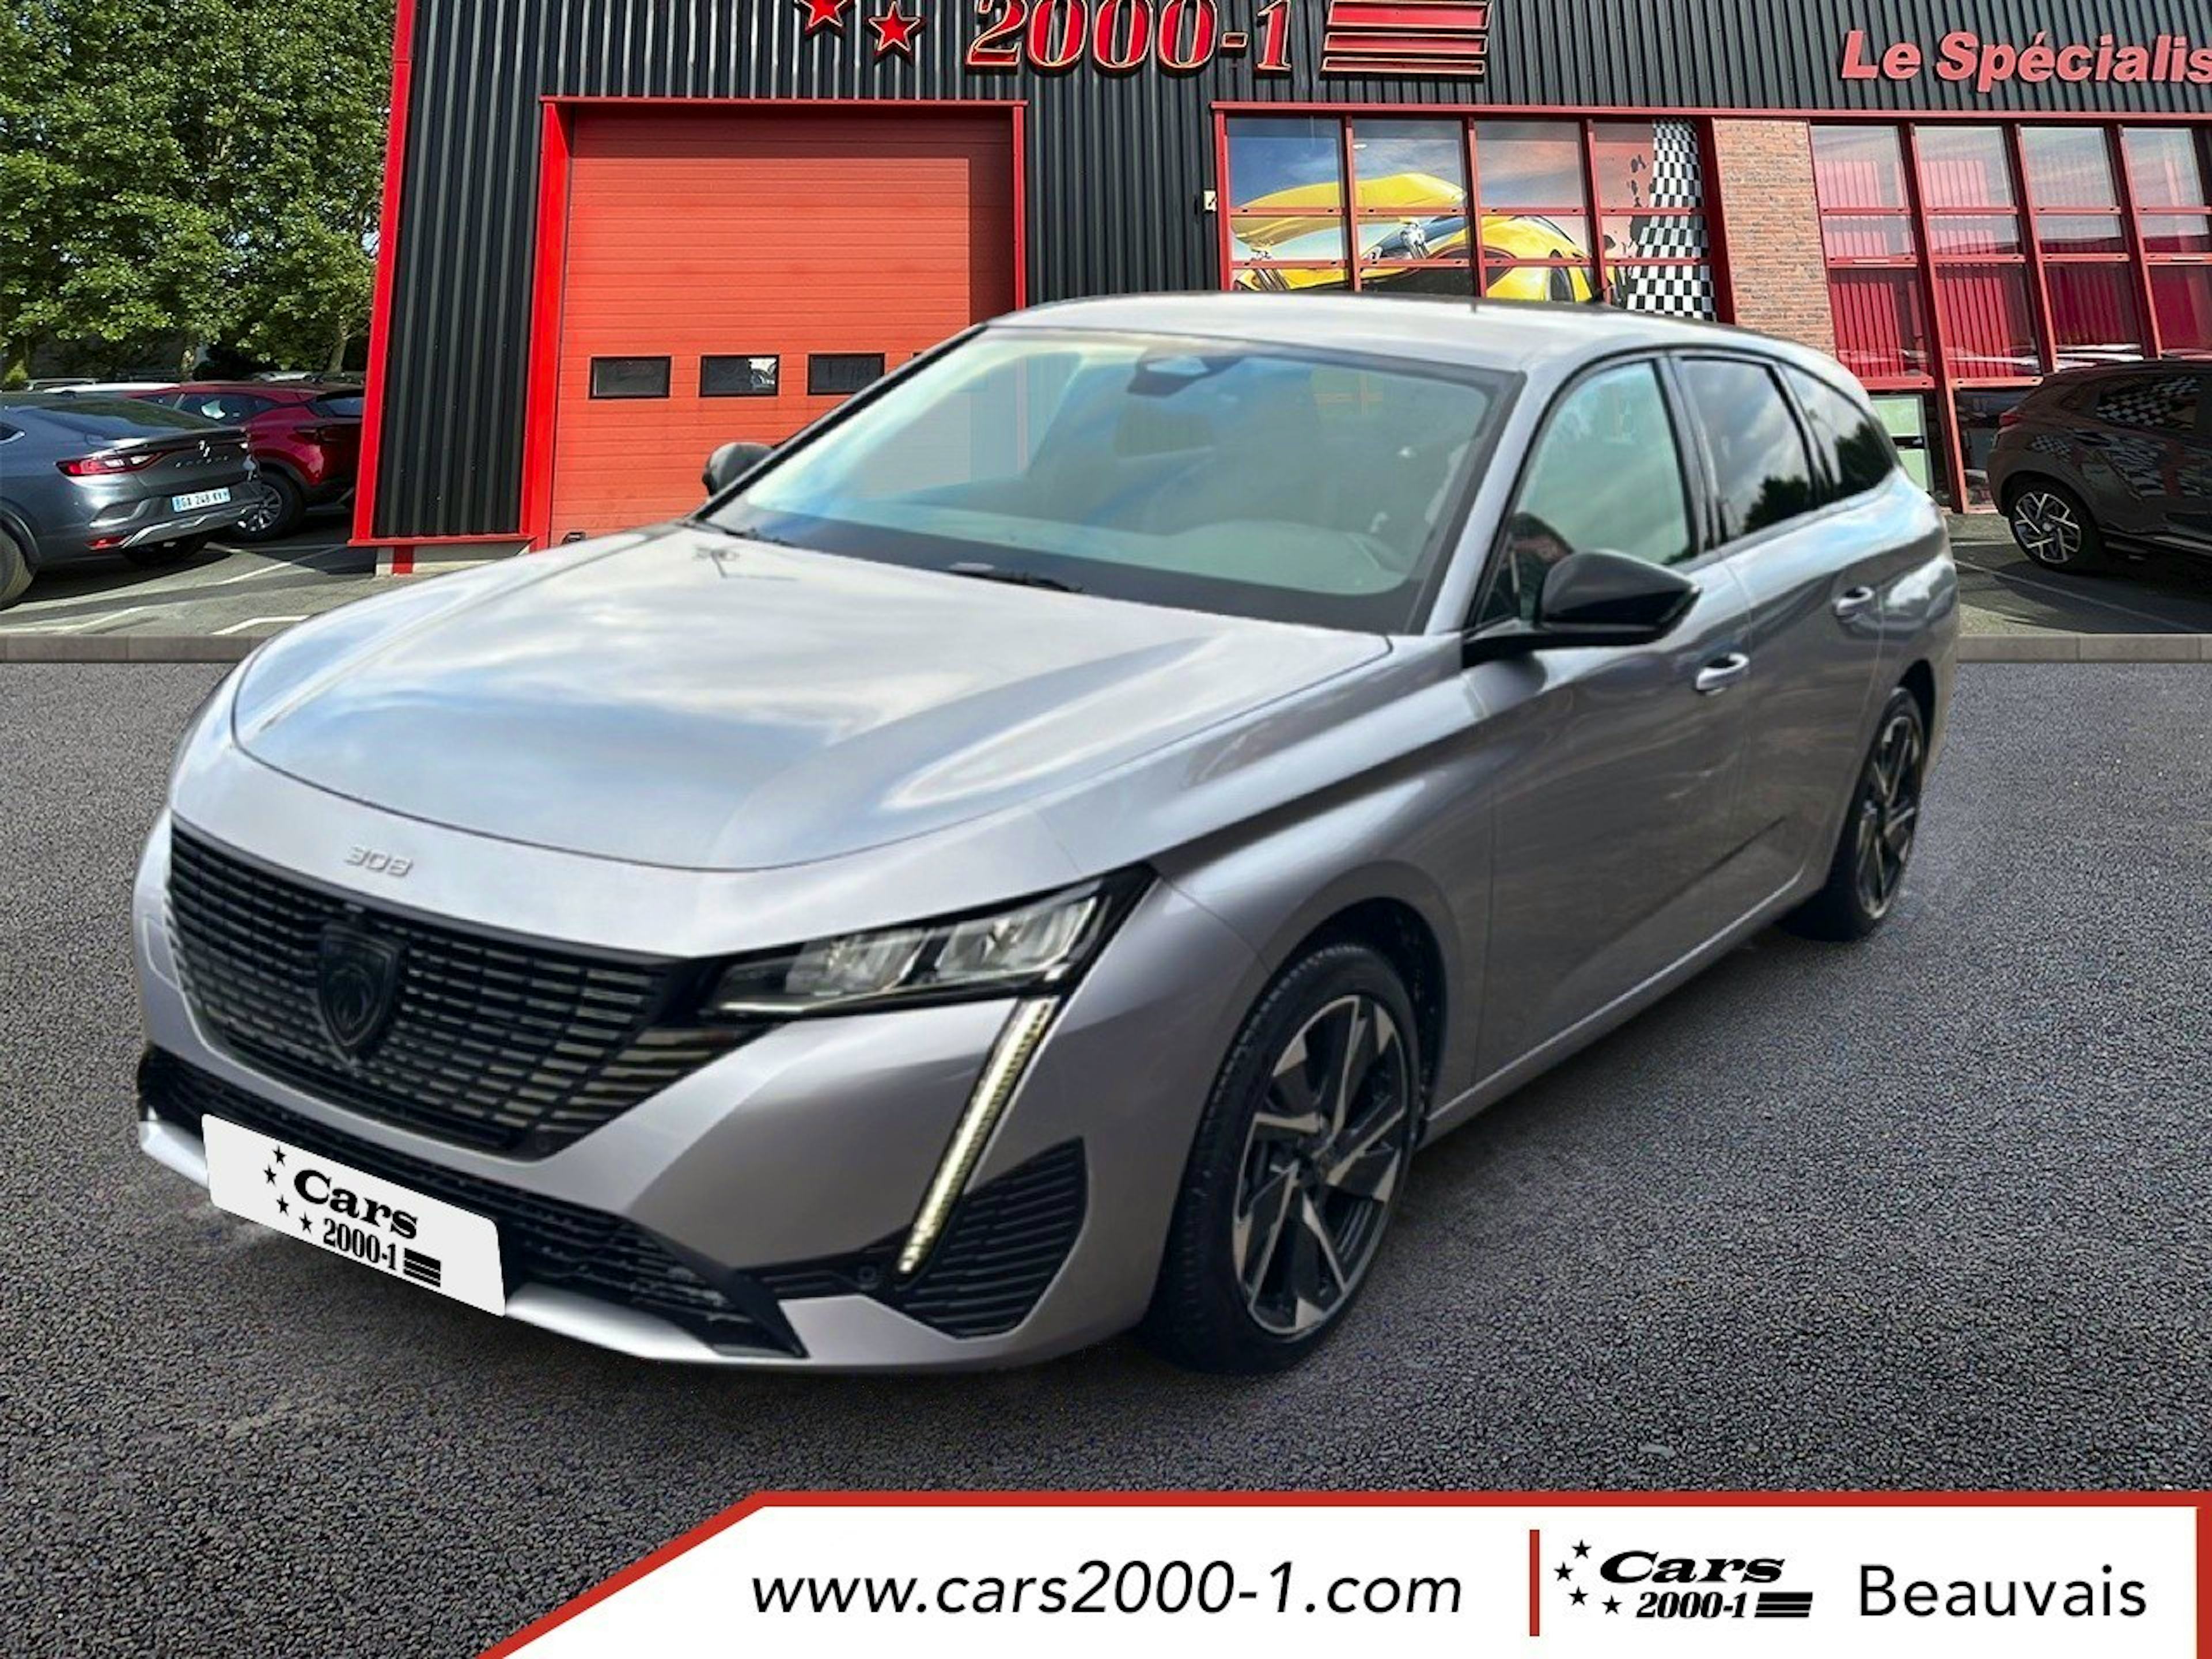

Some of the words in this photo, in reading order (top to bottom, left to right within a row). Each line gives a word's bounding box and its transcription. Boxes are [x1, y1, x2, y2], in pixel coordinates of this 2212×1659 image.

[964, 0, 1292, 74] 2000-1
[1841, 29, 1922, 79] Le
[344, 845, 414, 878] 308
[293, 1169, 418, 1239] Cars
[323, 1218, 396, 1271] 2000-1
